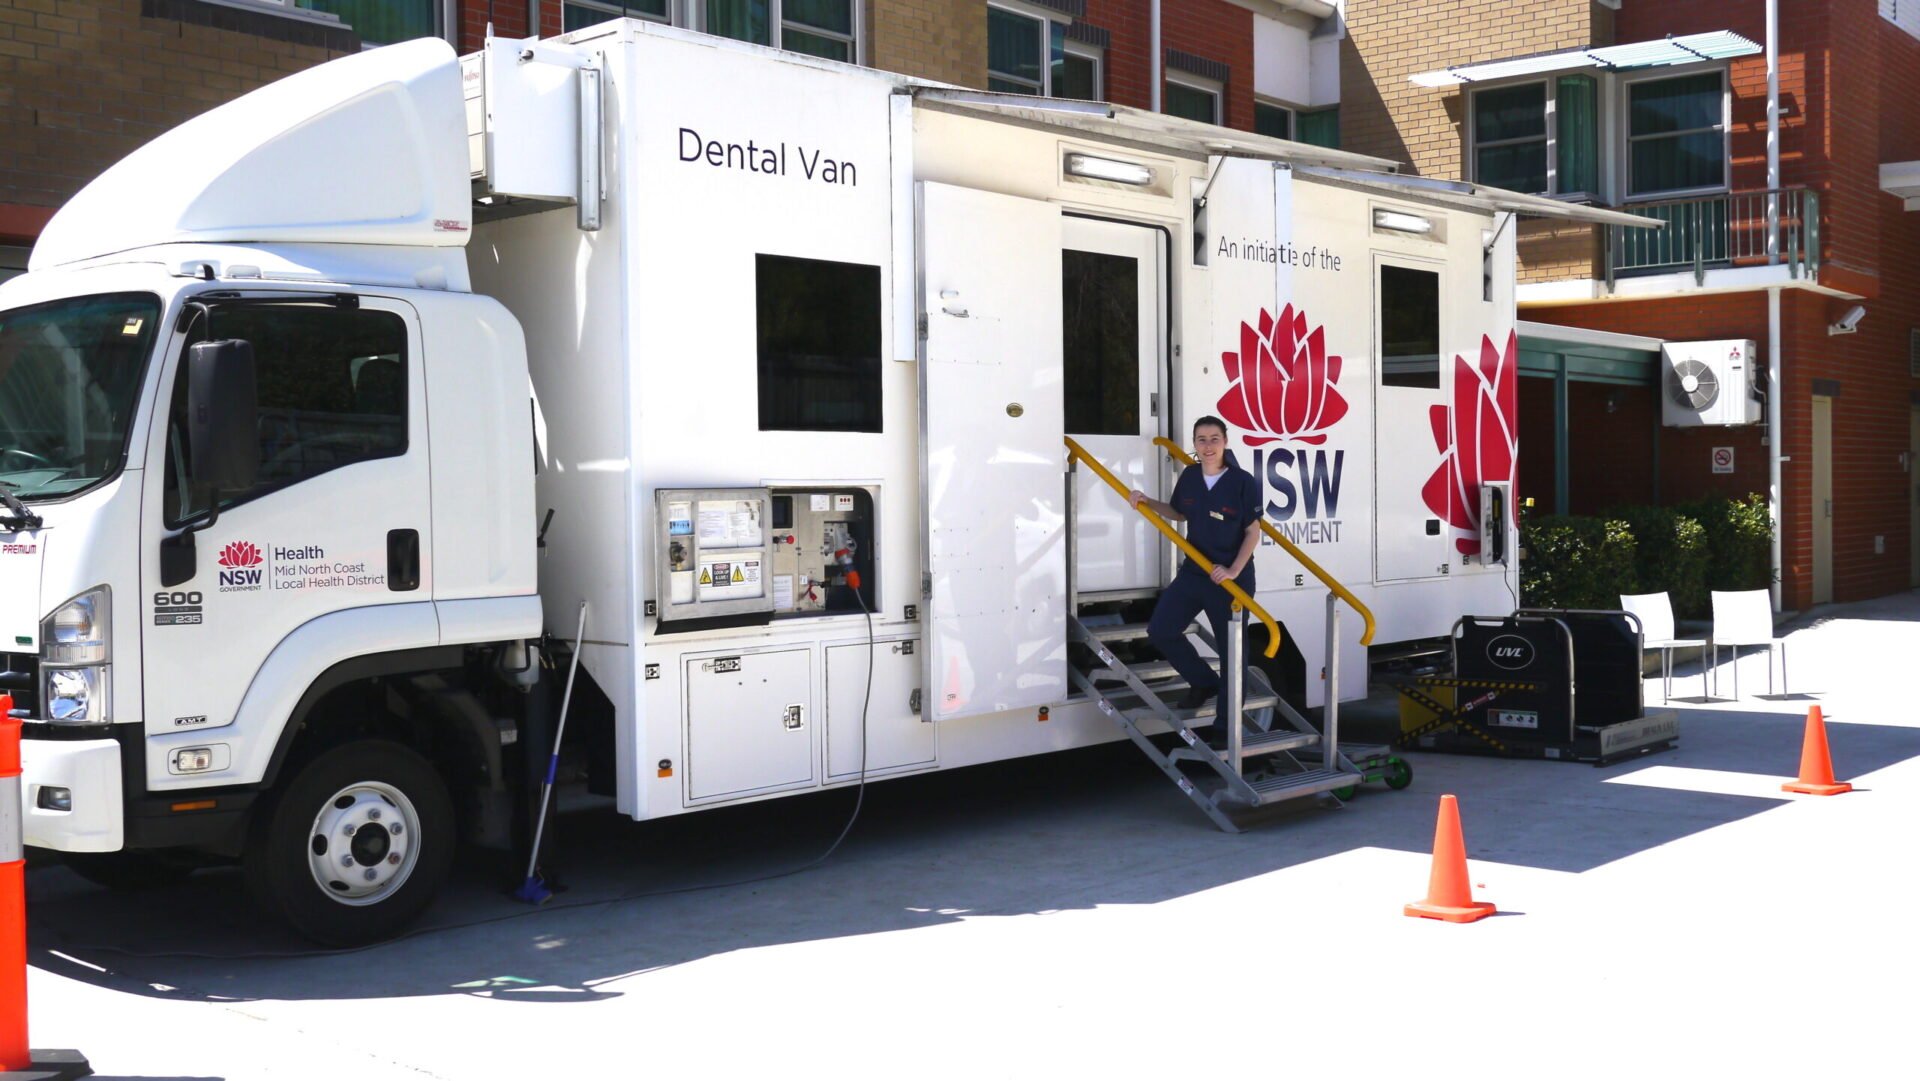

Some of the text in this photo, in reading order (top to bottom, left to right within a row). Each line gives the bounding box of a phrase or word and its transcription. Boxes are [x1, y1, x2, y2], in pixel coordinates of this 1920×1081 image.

[679, 127, 856, 187] Dental Van
[1218, 235, 1237, 258] An
[1302, 246, 1316, 268] of
[1320, 248, 1341, 271] the
[3, 545, 37, 554] PREMIUM
[275, 545, 324, 560] Health
[275, 562, 365, 576] Mid North Coast
[219, 569, 262, 586] NSW
[275, 574, 384, 590] Local Health District
[154, 591, 203, 606] 600
[175, 615, 201, 624] 235
[1495, 647, 1523, 657] UVL
[181, 716, 203, 725] AMT
